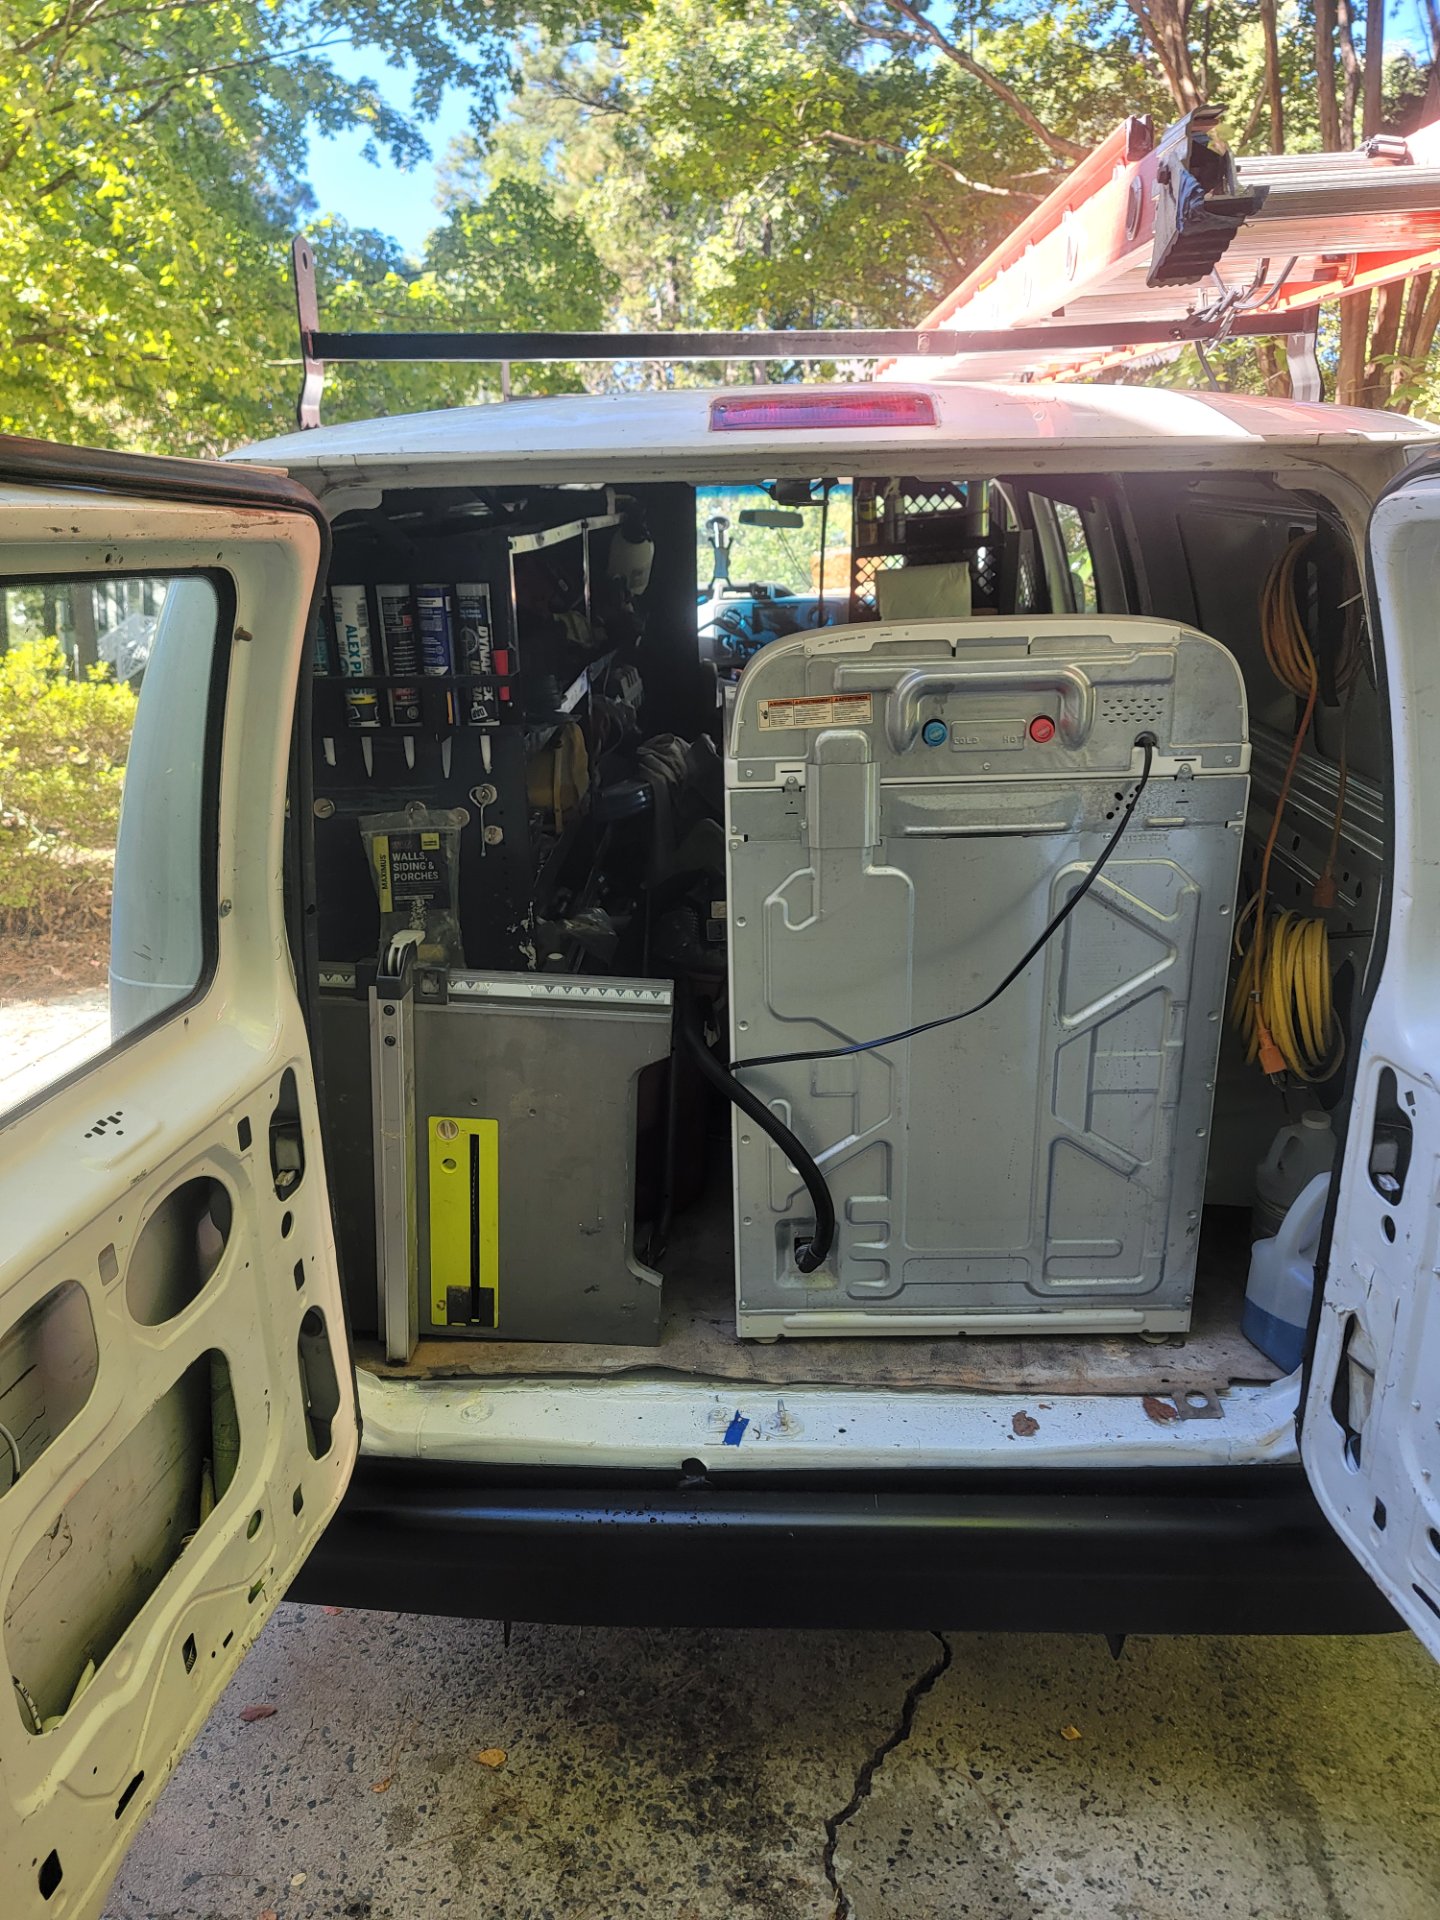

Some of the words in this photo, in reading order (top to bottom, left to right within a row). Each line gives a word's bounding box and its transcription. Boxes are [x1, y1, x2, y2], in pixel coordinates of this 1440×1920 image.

[346, 624, 361, 658] ALEX
[477, 625, 493, 701] DYNAFEX
[350, 661, 365, 695] PLS
[953, 736, 980, 744] COLD
[1002, 735, 1024, 744] HOT
[392, 851, 427, 861] WALLS,
[393, 861, 427, 871] SIDING
[428, 861, 434, 870] &
[380, 854, 388, 889] MAXIMUS
[393, 871, 438, 881] PORCHES
